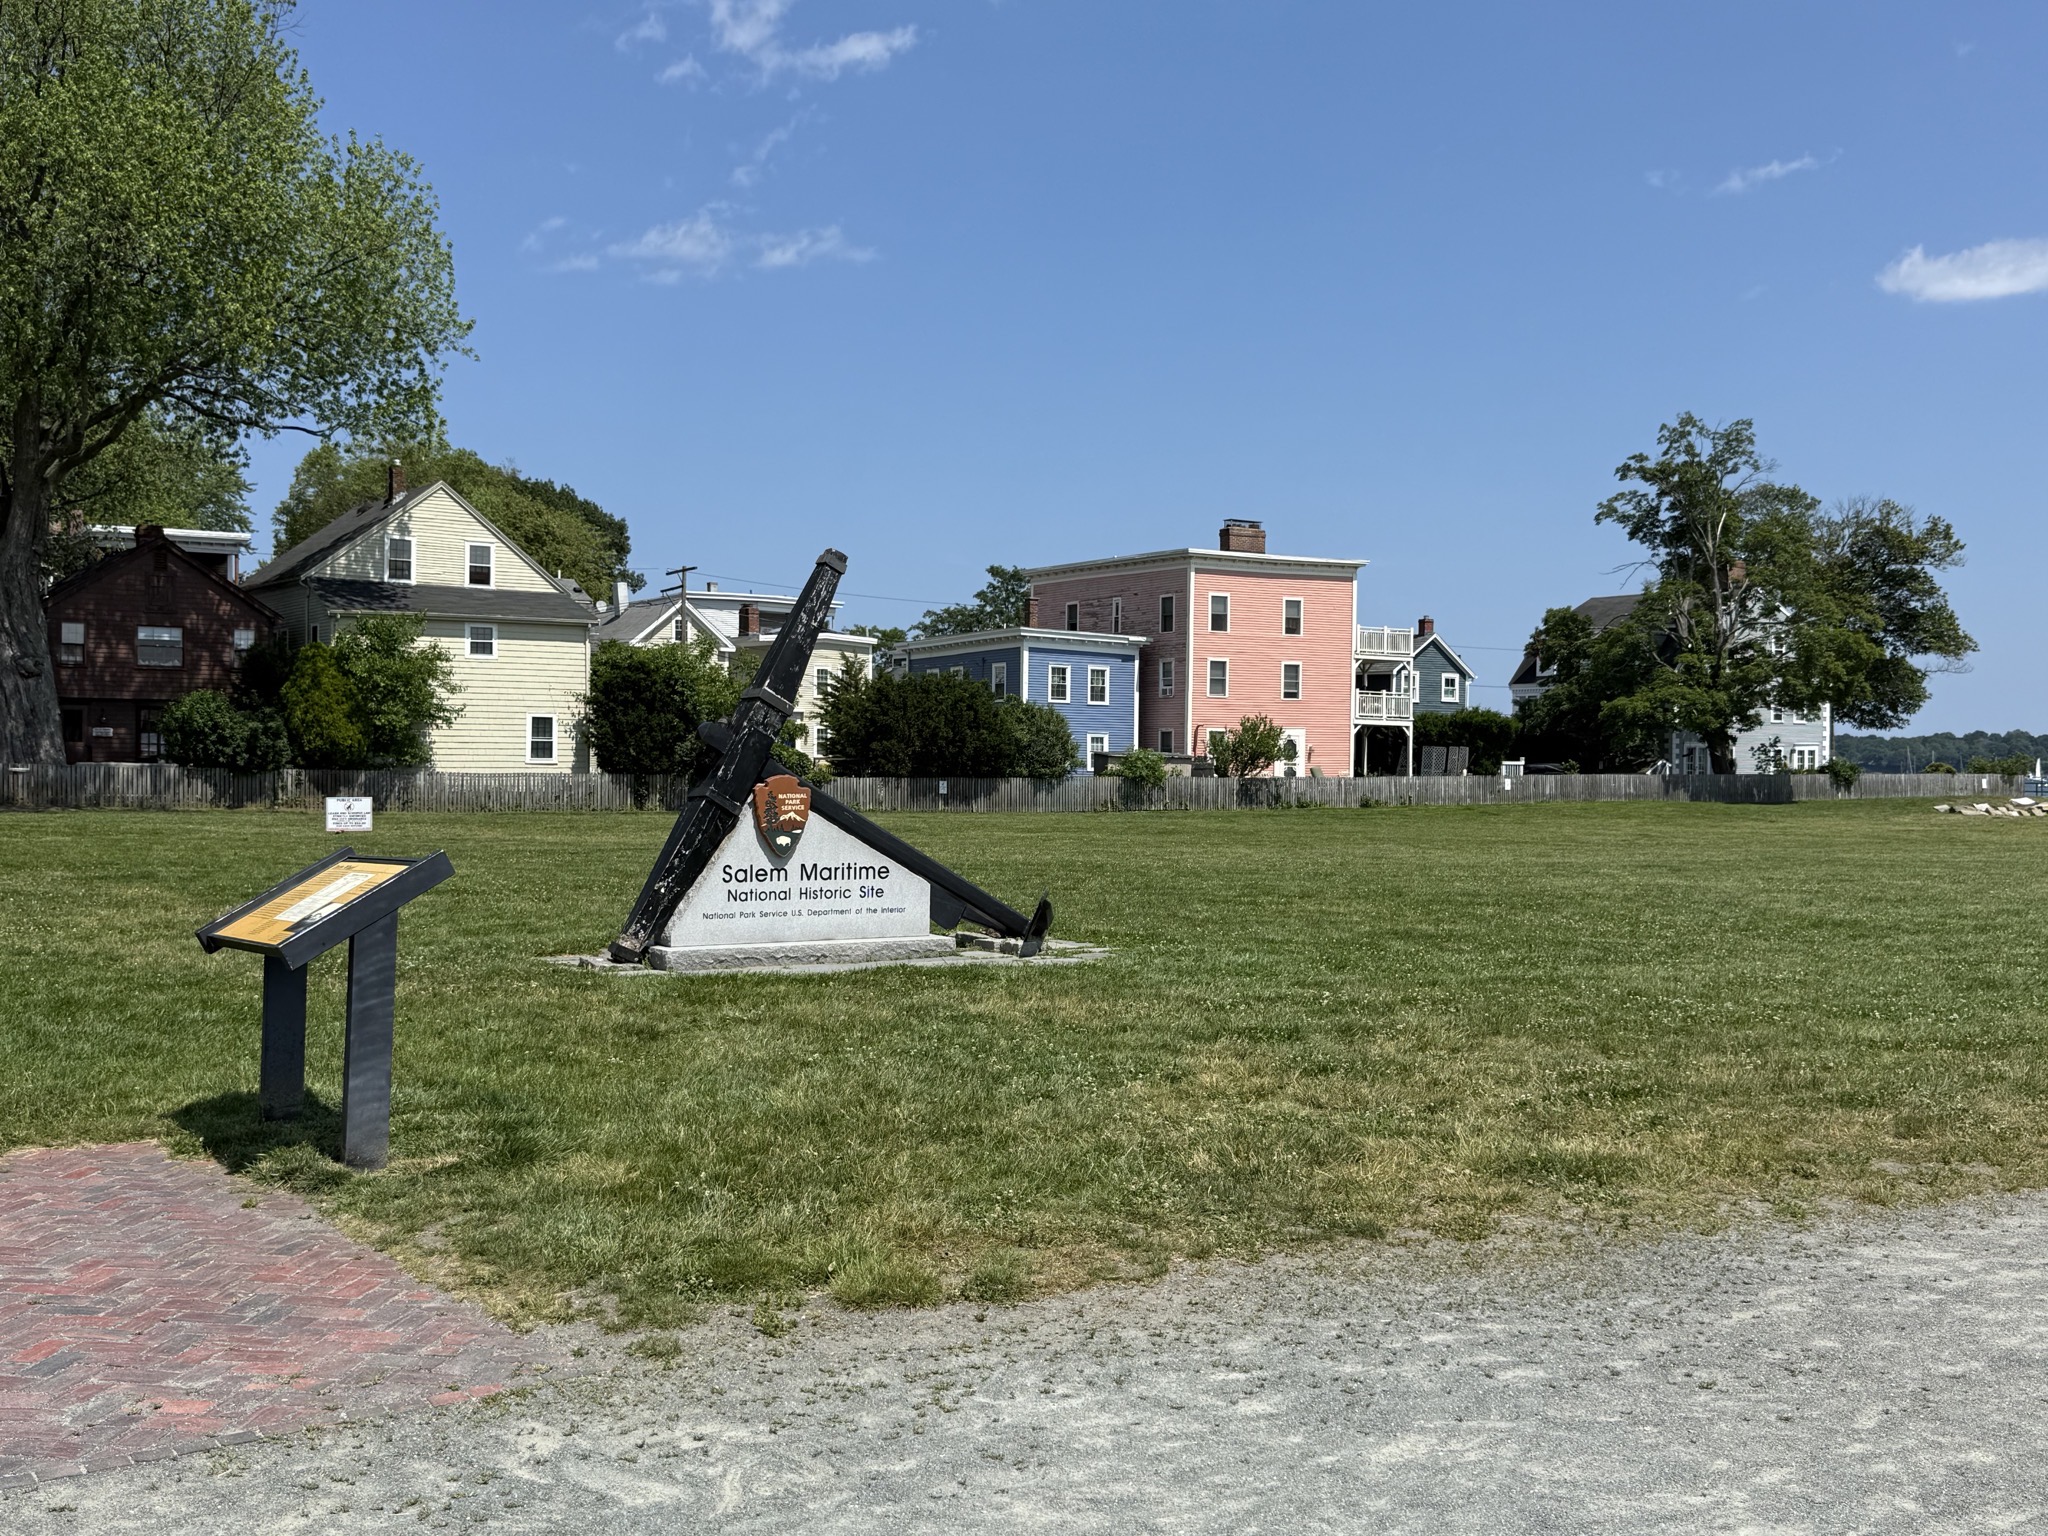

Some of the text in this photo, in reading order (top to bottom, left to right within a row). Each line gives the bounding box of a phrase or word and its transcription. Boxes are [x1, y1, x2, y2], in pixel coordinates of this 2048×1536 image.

[722, 862, 890, 883] Salem Maritime
[727, 885, 885, 902] National Historic Site
[702, 911, 736, 920] National
[739, 911, 756, 919] Park
[759, 909, 788, 918] Service
[791, 909, 804, 917] U.S.
[807, 907, 852, 917] Department
[855, 907, 863, 915] of
